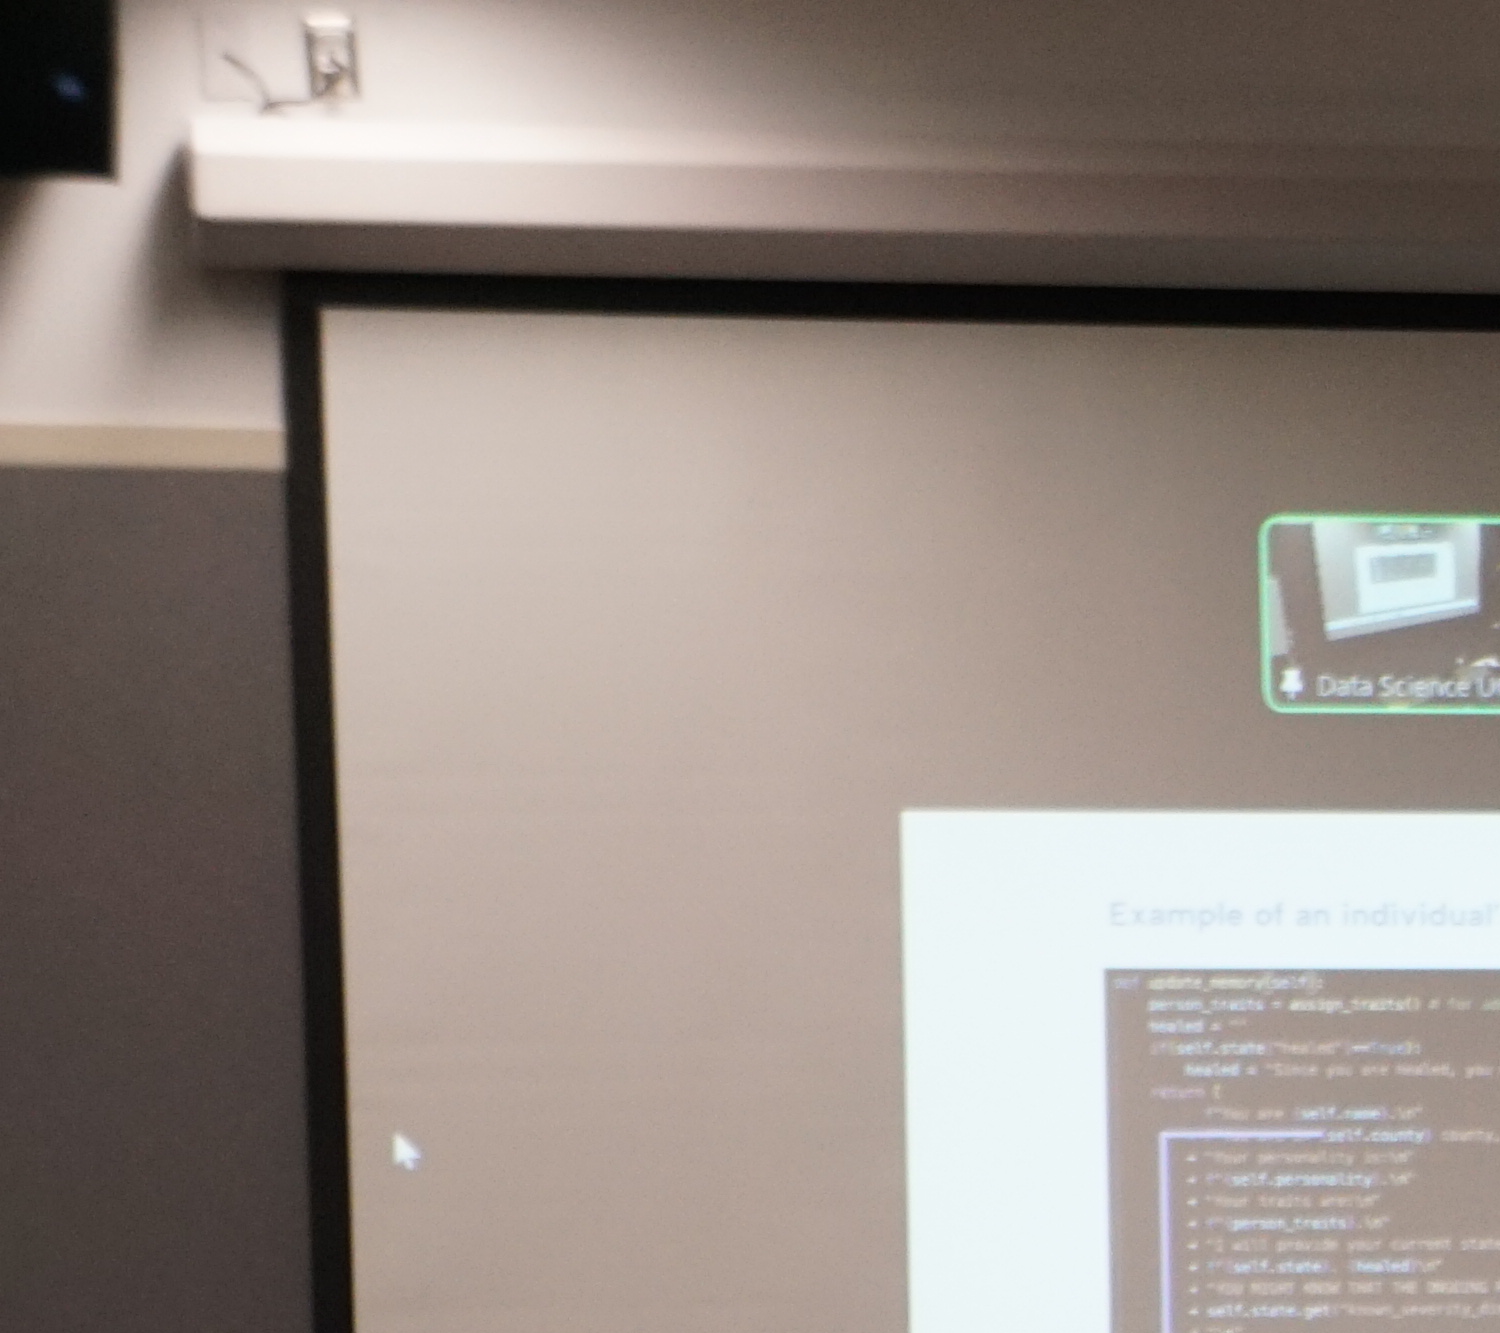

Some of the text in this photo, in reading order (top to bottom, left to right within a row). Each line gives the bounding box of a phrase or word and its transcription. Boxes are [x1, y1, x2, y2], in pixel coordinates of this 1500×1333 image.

[1316, 676, 1374, 697] Data
[1379, 676, 1471, 698] Science
[1108, 901, 1244, 932] Example
[1254, 902, 1285, 927] of
[1295, 907, 1332, 927] an
